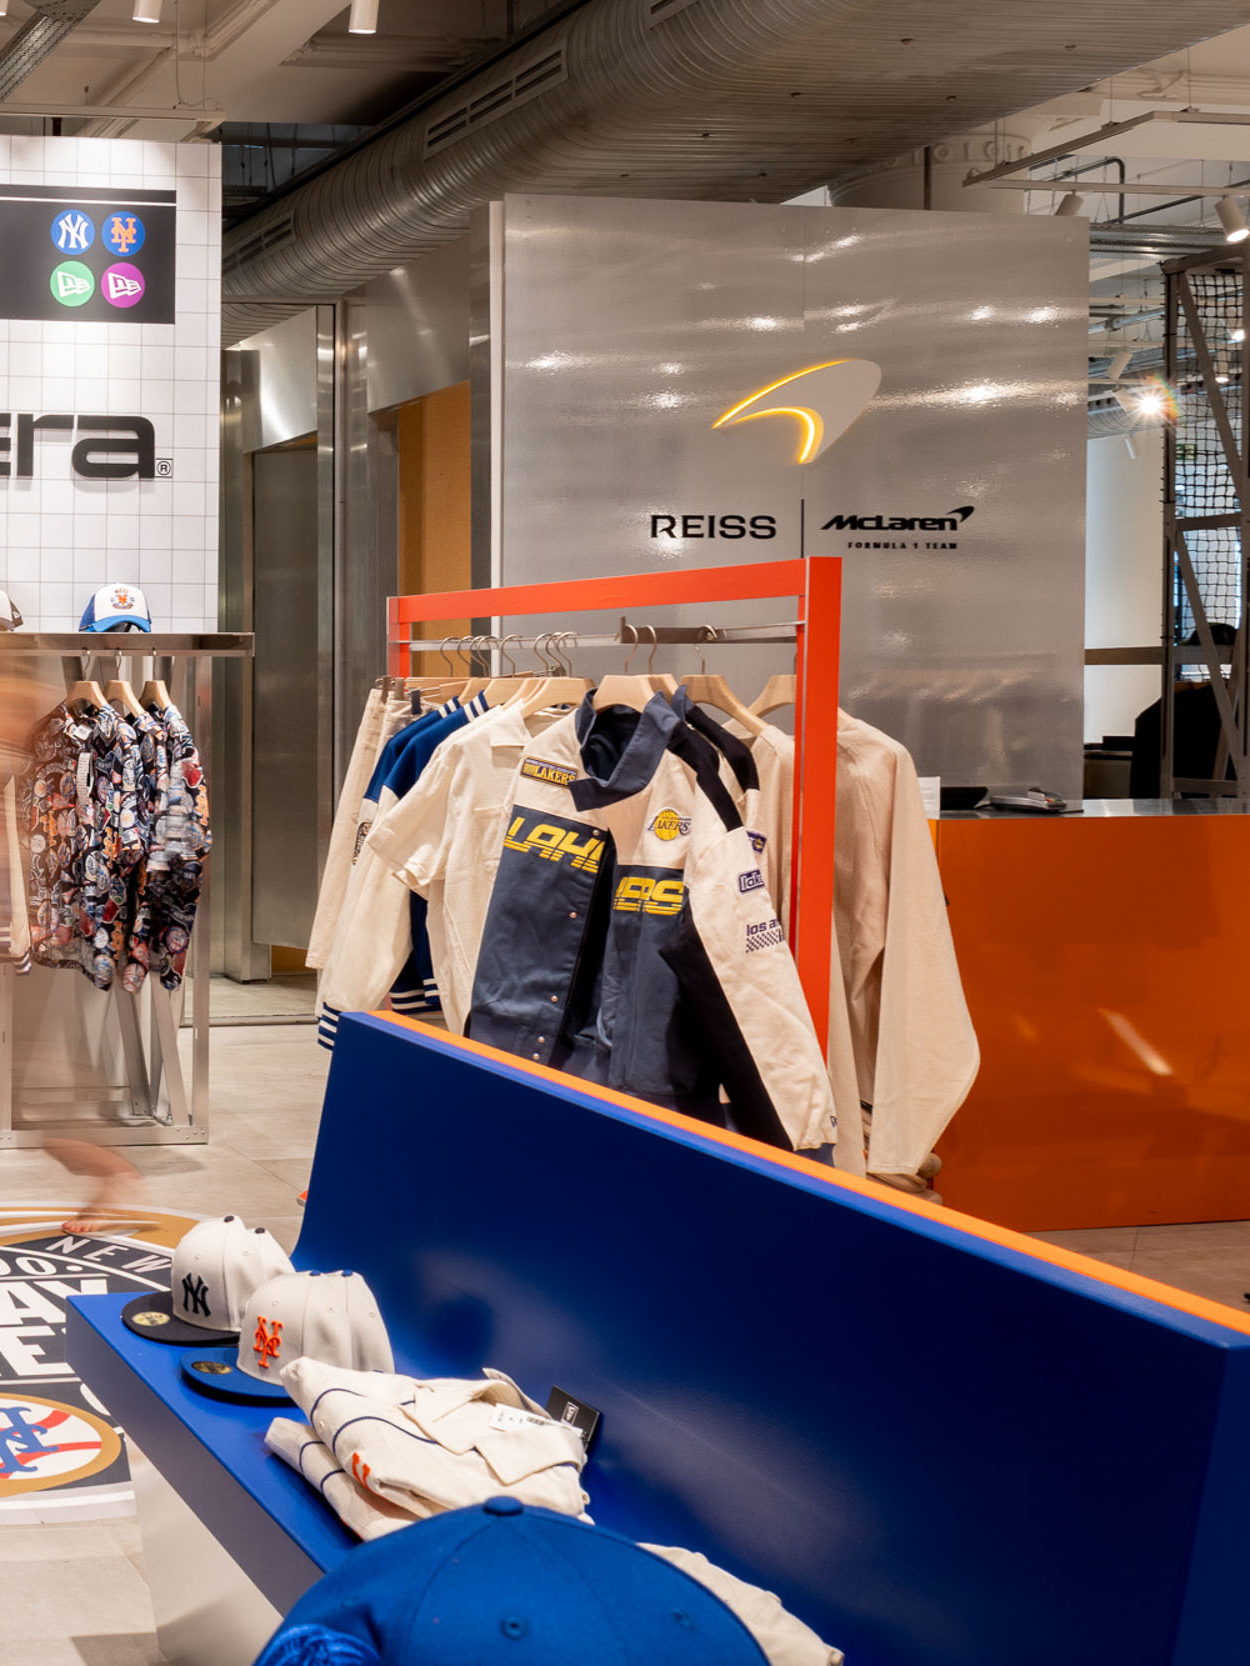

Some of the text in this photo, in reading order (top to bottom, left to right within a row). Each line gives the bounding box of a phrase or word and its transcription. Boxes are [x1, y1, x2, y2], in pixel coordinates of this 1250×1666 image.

[650, 514, 958, 540] REISS McLaren
[647, 815, 692, 836] LAKERS
[746, 922, 767, 936] los
[45, 1235, 172, 1273] NEW
